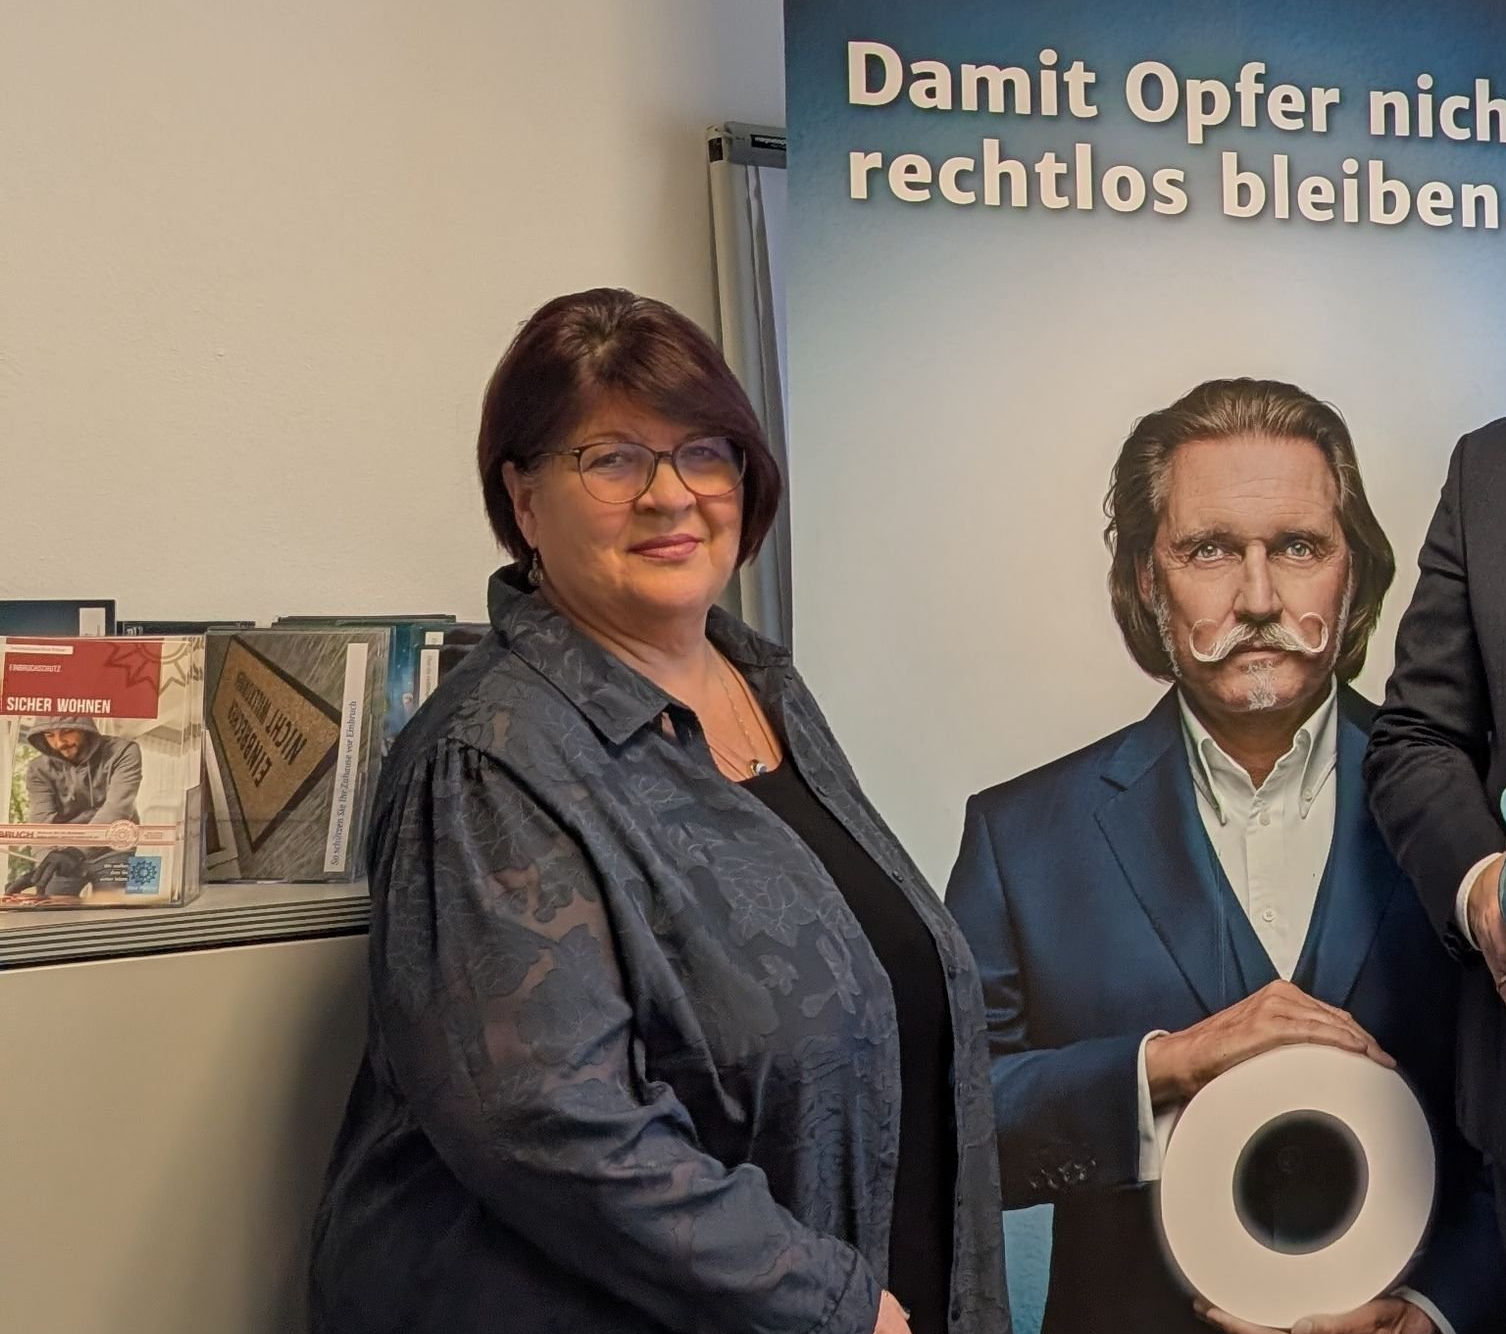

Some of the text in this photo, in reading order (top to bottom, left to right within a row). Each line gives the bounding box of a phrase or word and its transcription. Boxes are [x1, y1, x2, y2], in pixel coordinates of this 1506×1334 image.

[848, 41, 1098, 118] Damit
[1125, 61, 1340, 145] Opfer
[848, 139, 1188, 215] rechtlos
[6, 697, 111, 713] SICHER WOHNEN
[346, 701, 357, 738] Einbruch
[265, 708, 307, 765] NICHT
[340, 755, 353, 789] Zuhause
[337, 804, 346, 816] Sie
[331, 855, 339, 865] So
